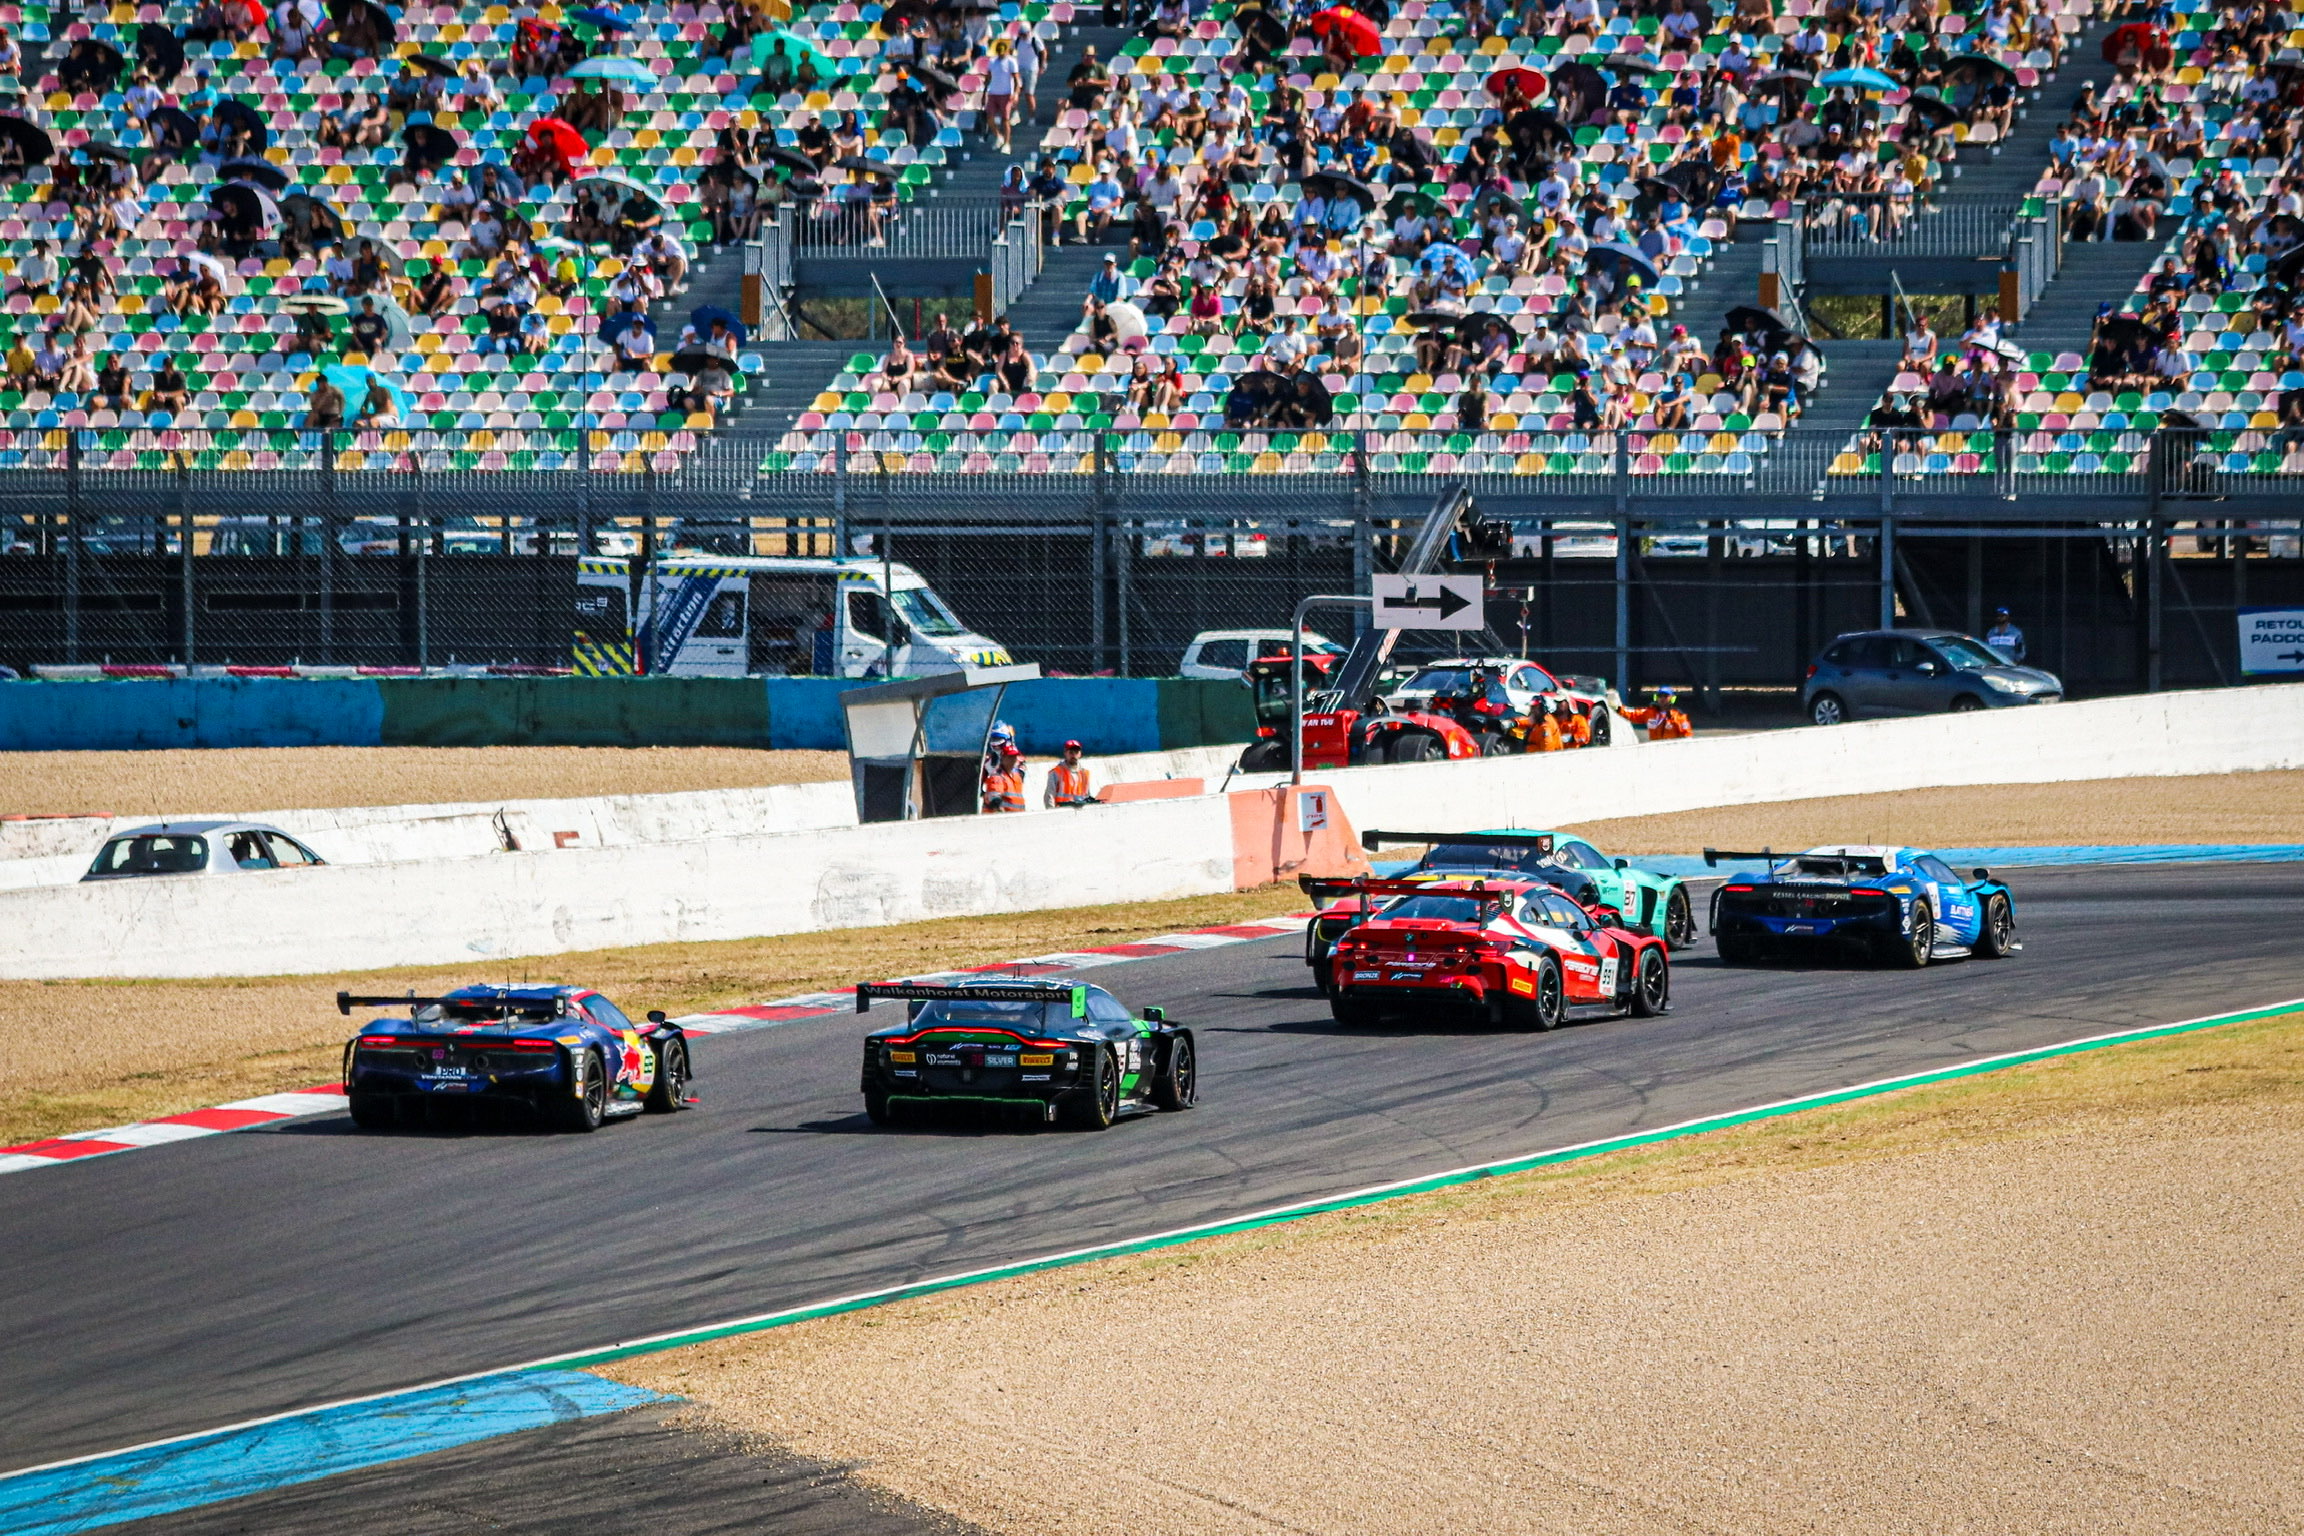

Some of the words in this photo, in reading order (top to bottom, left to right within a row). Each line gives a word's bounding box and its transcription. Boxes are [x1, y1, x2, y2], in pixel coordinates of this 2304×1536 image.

[864, 986, 970, 998] Walkenhorst
[975, 989, 1070, 1001] Motorsport
[986, 1056, 1014, 1065] SILVER
[1022, 1055, 1052, 1064] PIRELLI
[440, 1067, 461, 1076] PRO
